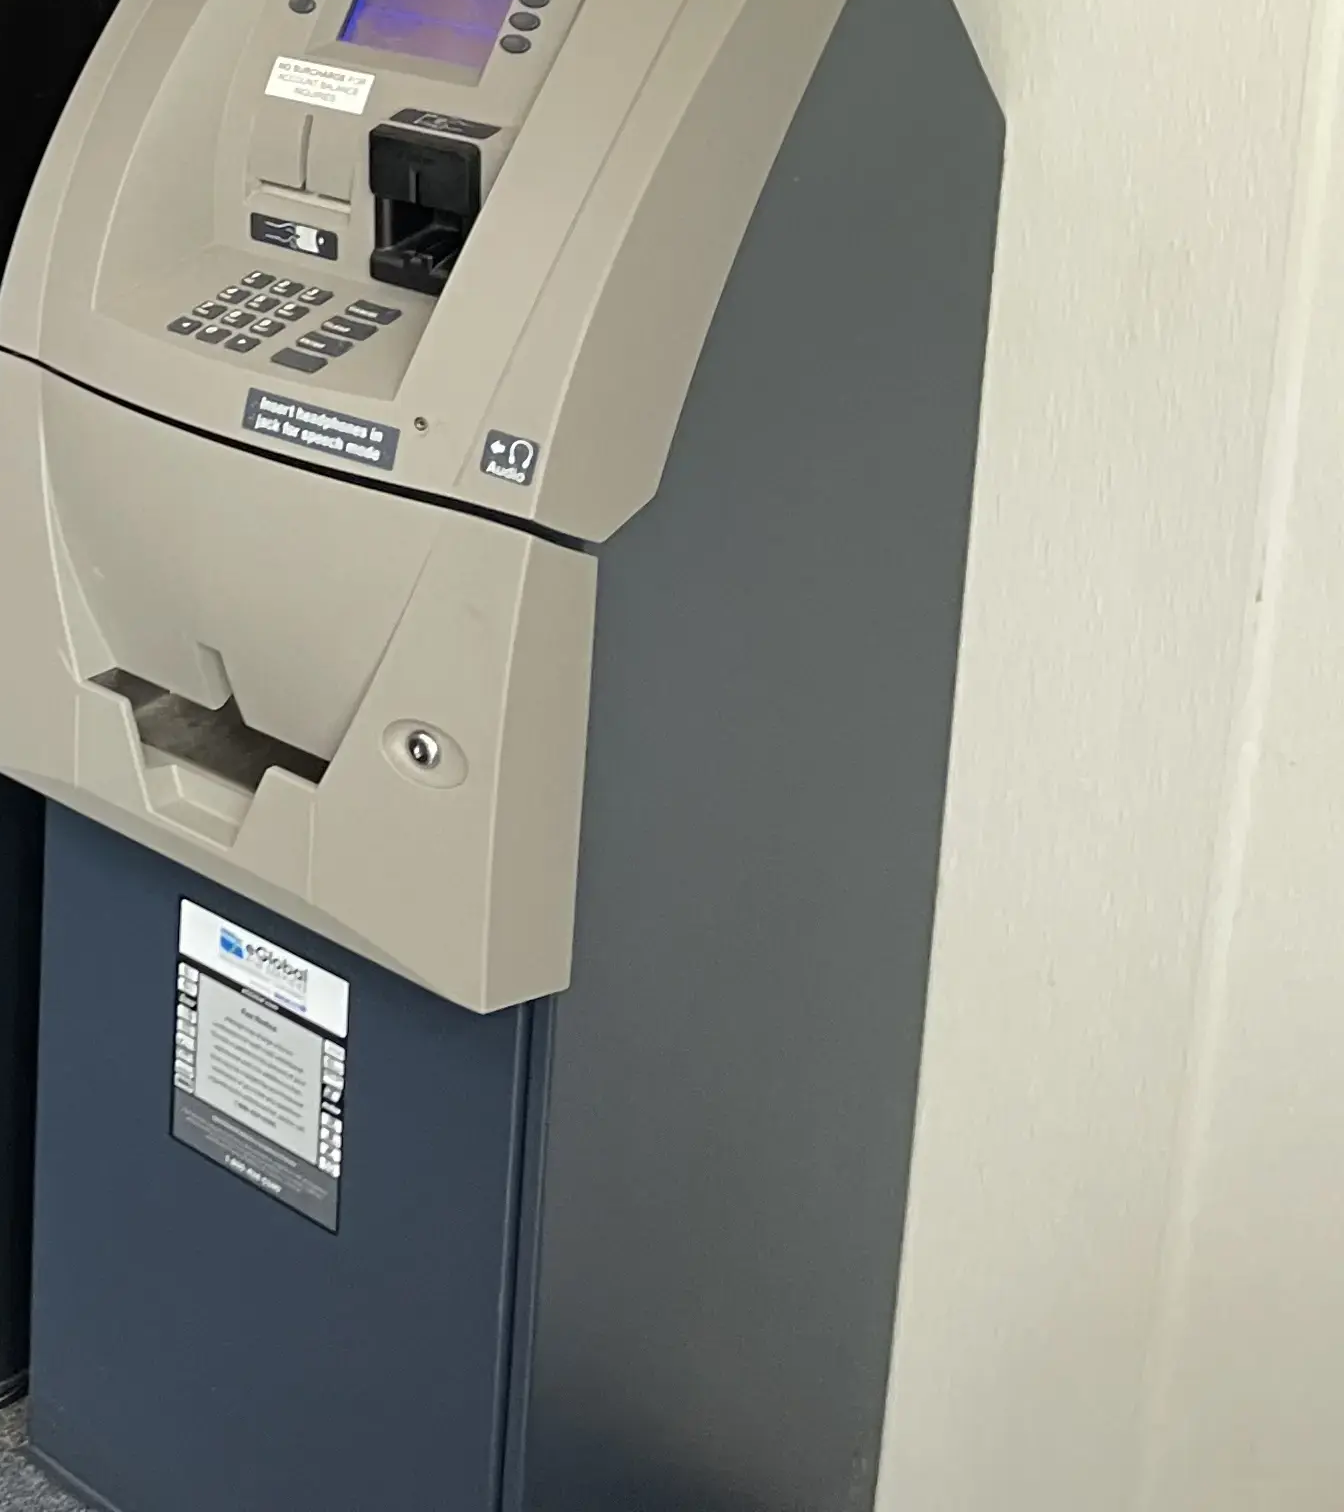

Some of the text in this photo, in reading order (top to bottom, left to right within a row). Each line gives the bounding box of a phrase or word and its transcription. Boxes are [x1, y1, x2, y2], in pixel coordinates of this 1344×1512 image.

[254, 413, 381, 461] jack for speech mode
[260, 396, 383, 442] Insert headphones in
[486, 460, 525, 483] Audio
[246, 944, 308, 981] eGlobal
